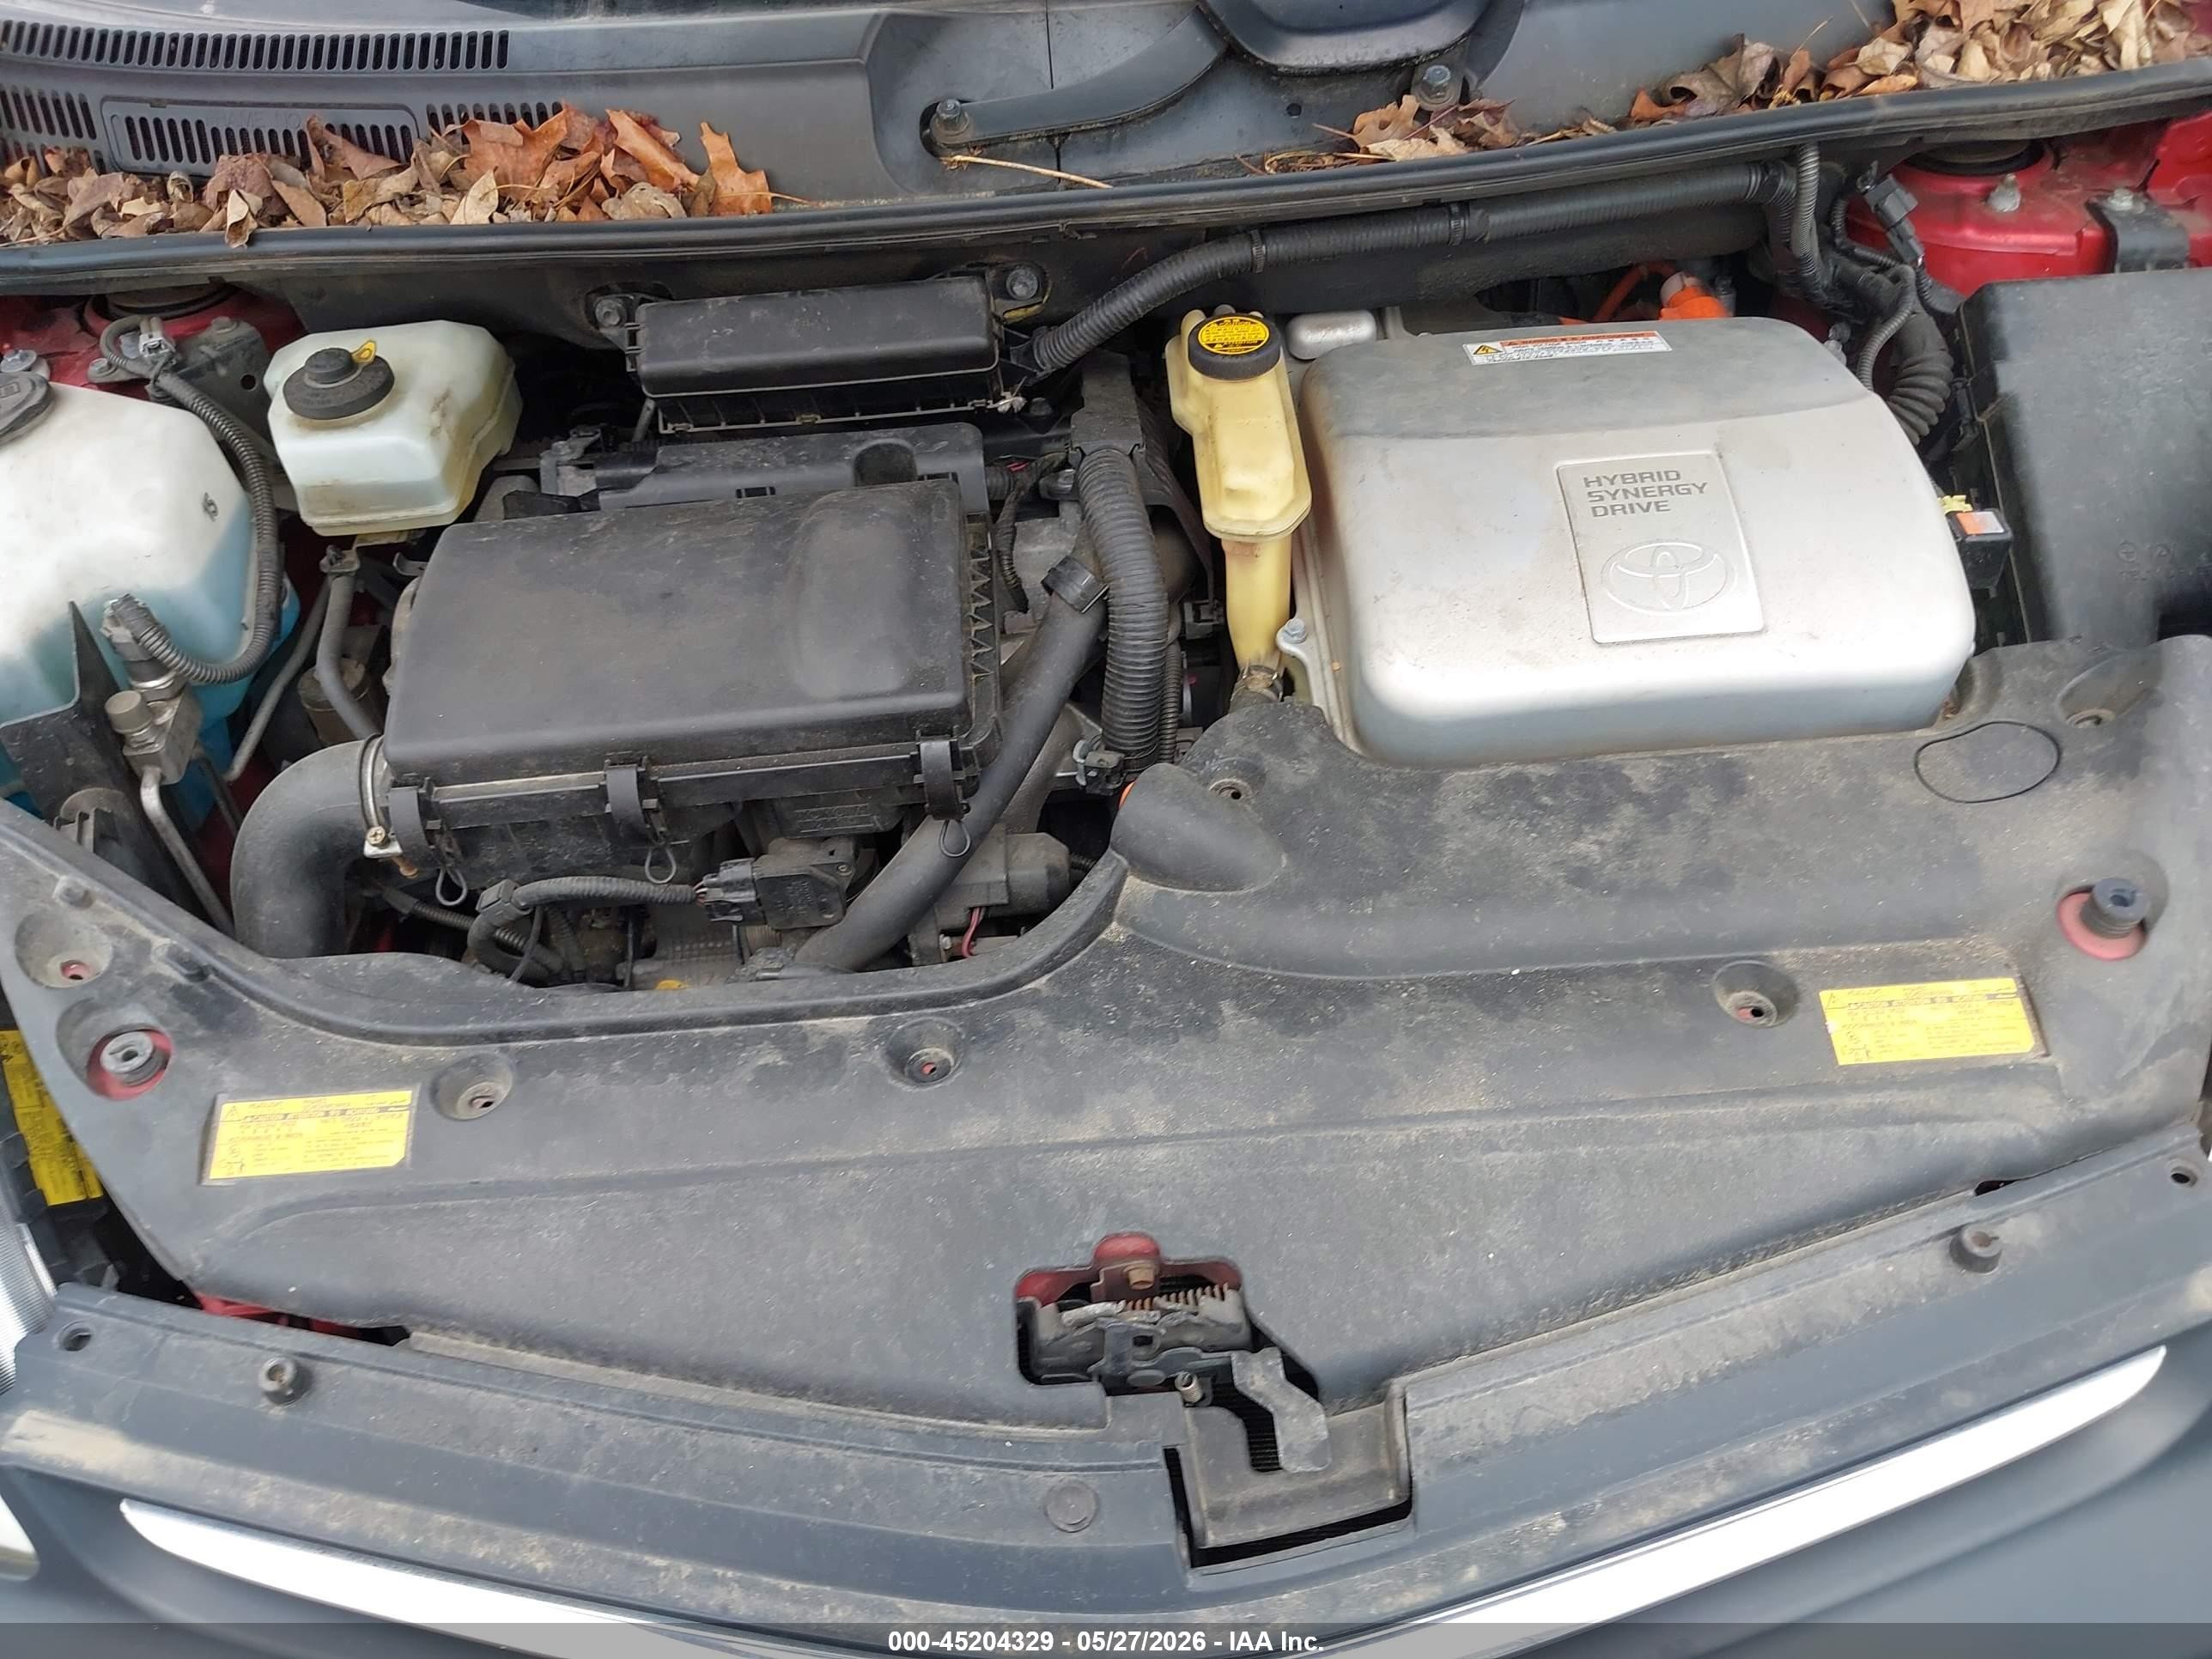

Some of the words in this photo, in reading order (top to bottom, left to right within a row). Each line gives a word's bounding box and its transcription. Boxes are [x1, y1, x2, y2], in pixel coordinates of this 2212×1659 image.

[1583, 470, 1681, 488] HYBRID
[1587, 482, 1708, 502] SYNERGY
[1591, 500, 1671, 517] DRIVE
